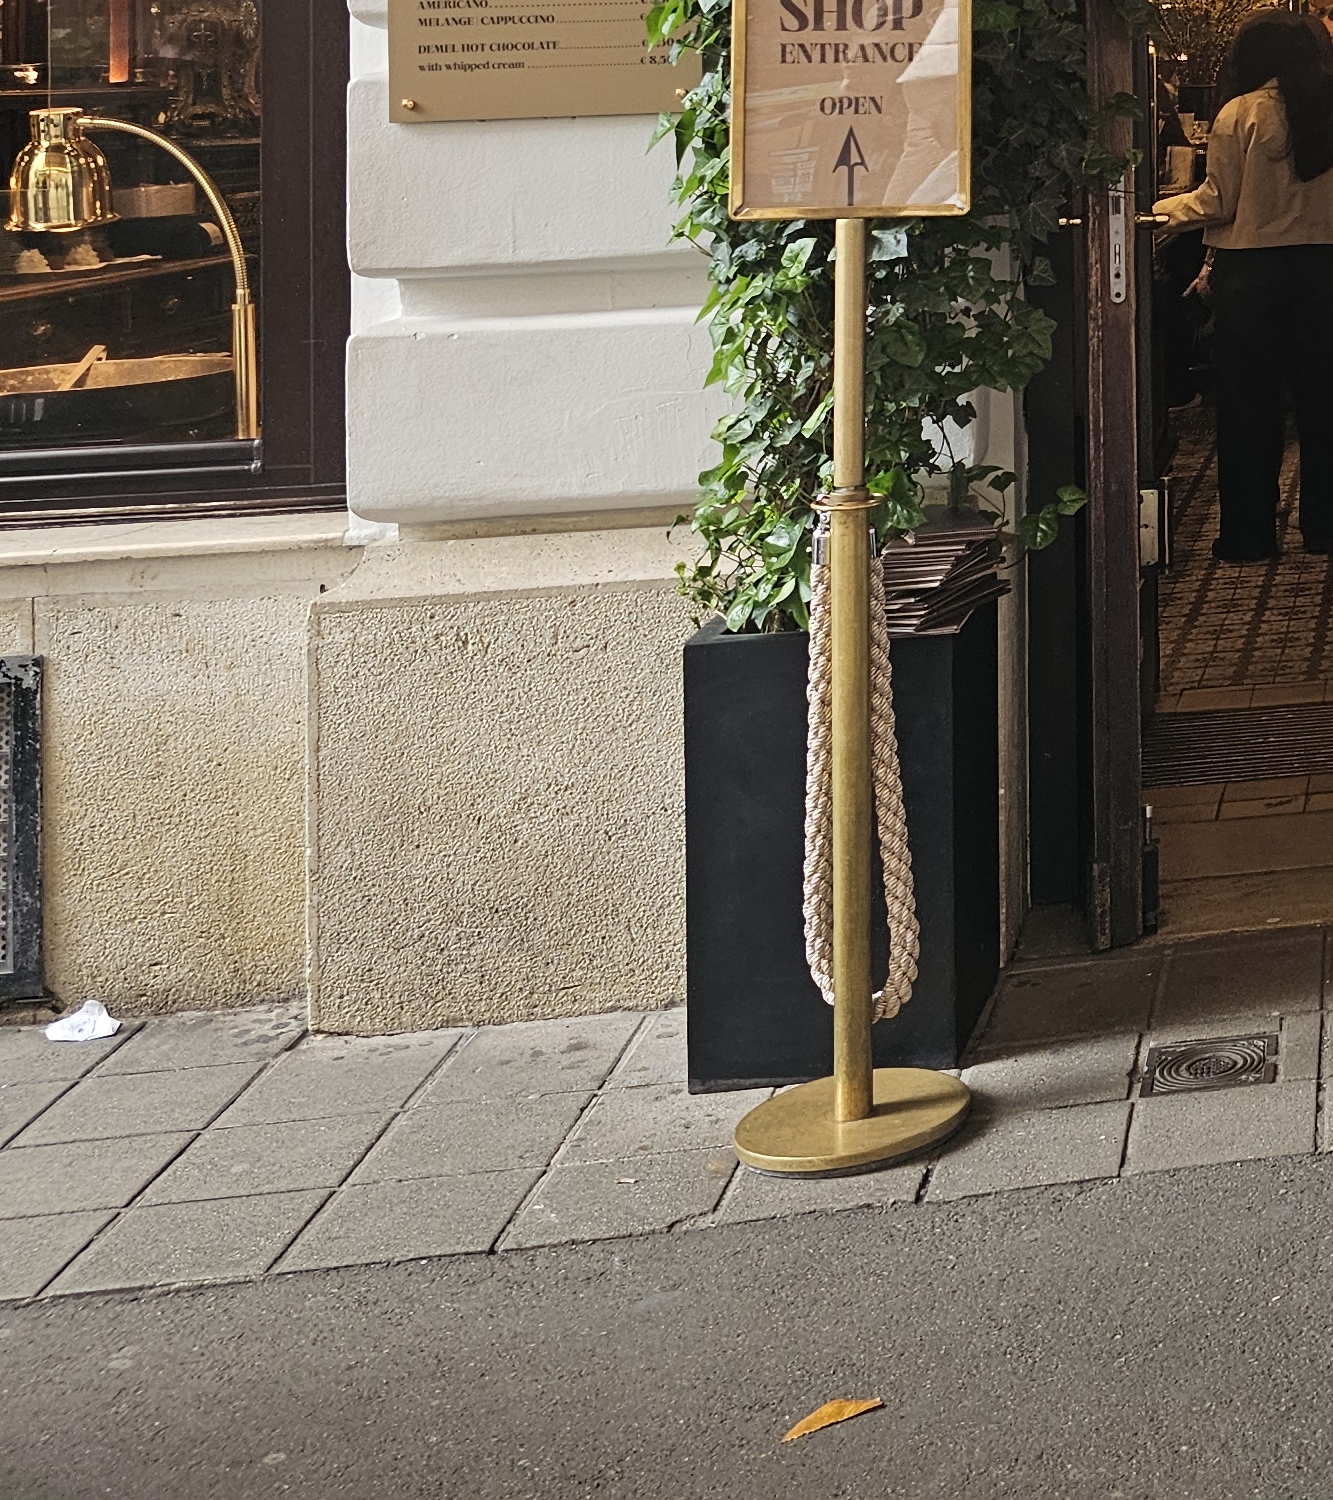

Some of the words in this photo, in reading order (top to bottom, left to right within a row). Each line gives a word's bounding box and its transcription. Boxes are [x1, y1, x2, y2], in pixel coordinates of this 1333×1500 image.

[417, 0, 488, 10] AMERICANO
[418, 16, 474, 27] MELANGE
[480, 14, 555, 26] CAPPUCCINO
[418, 44, 460, 54] DEMEL
[461, 43, 486, 53] HOT
[489, 41, 560, 52] CHOCOLATE
[780, 42, 923, 64] ENTRANCE
[418, 62, 442, 72] with
[445, 61, 490, 73] whipped
[492, 61, 525, 70] cream
[819, 95, 883, 115] OPEN
